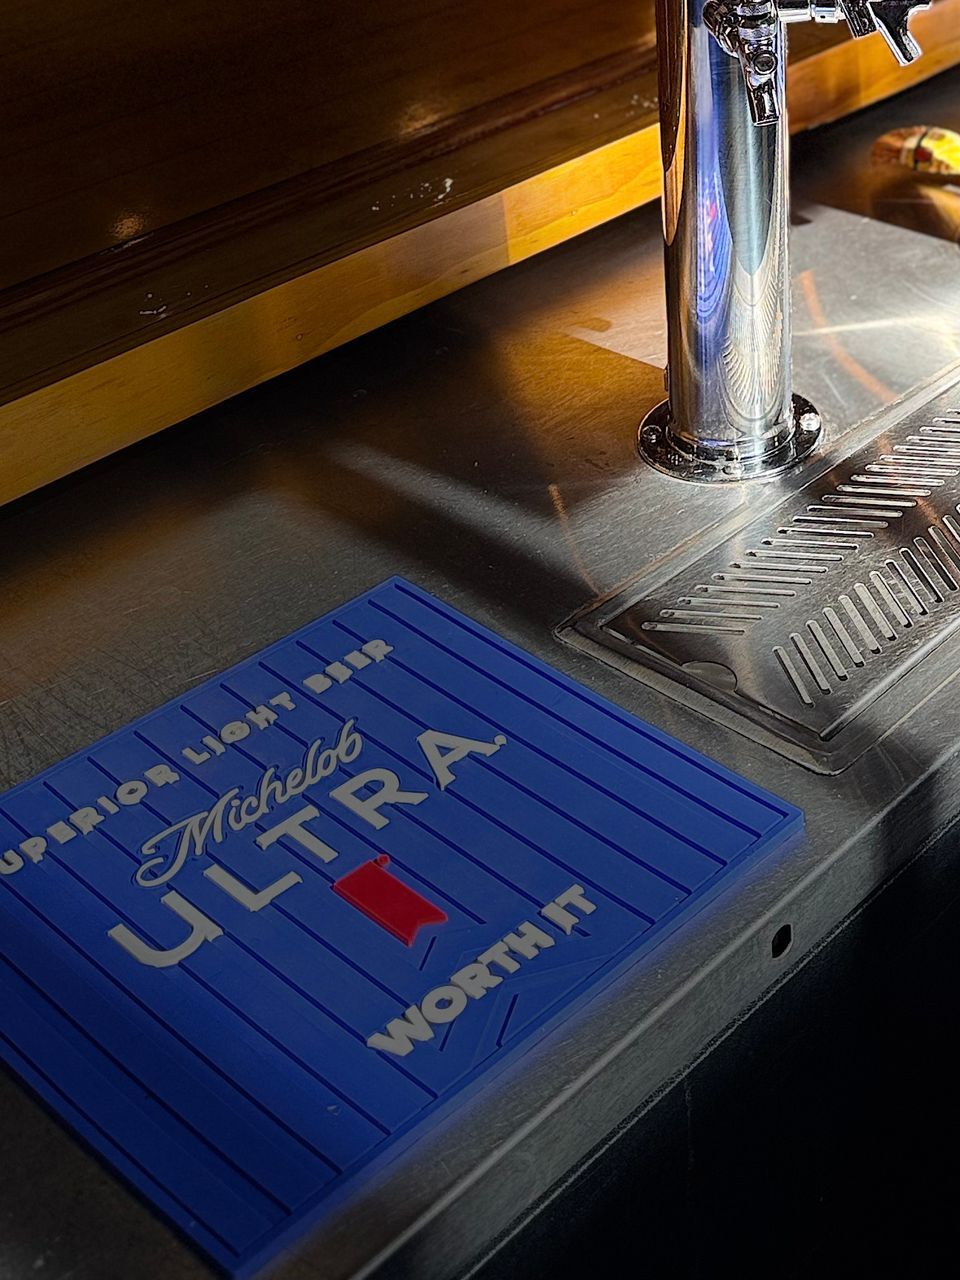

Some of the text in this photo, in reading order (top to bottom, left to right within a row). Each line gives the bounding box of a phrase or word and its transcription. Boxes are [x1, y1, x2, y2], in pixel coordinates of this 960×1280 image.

[0, 639, 394, 875] UPERIOR LIGHT BEER
[107, 728, 500, 968] ULTRA
[135, 717, 364, 888] Michelob
[367, 884, 597, 1058] WORTH IT
